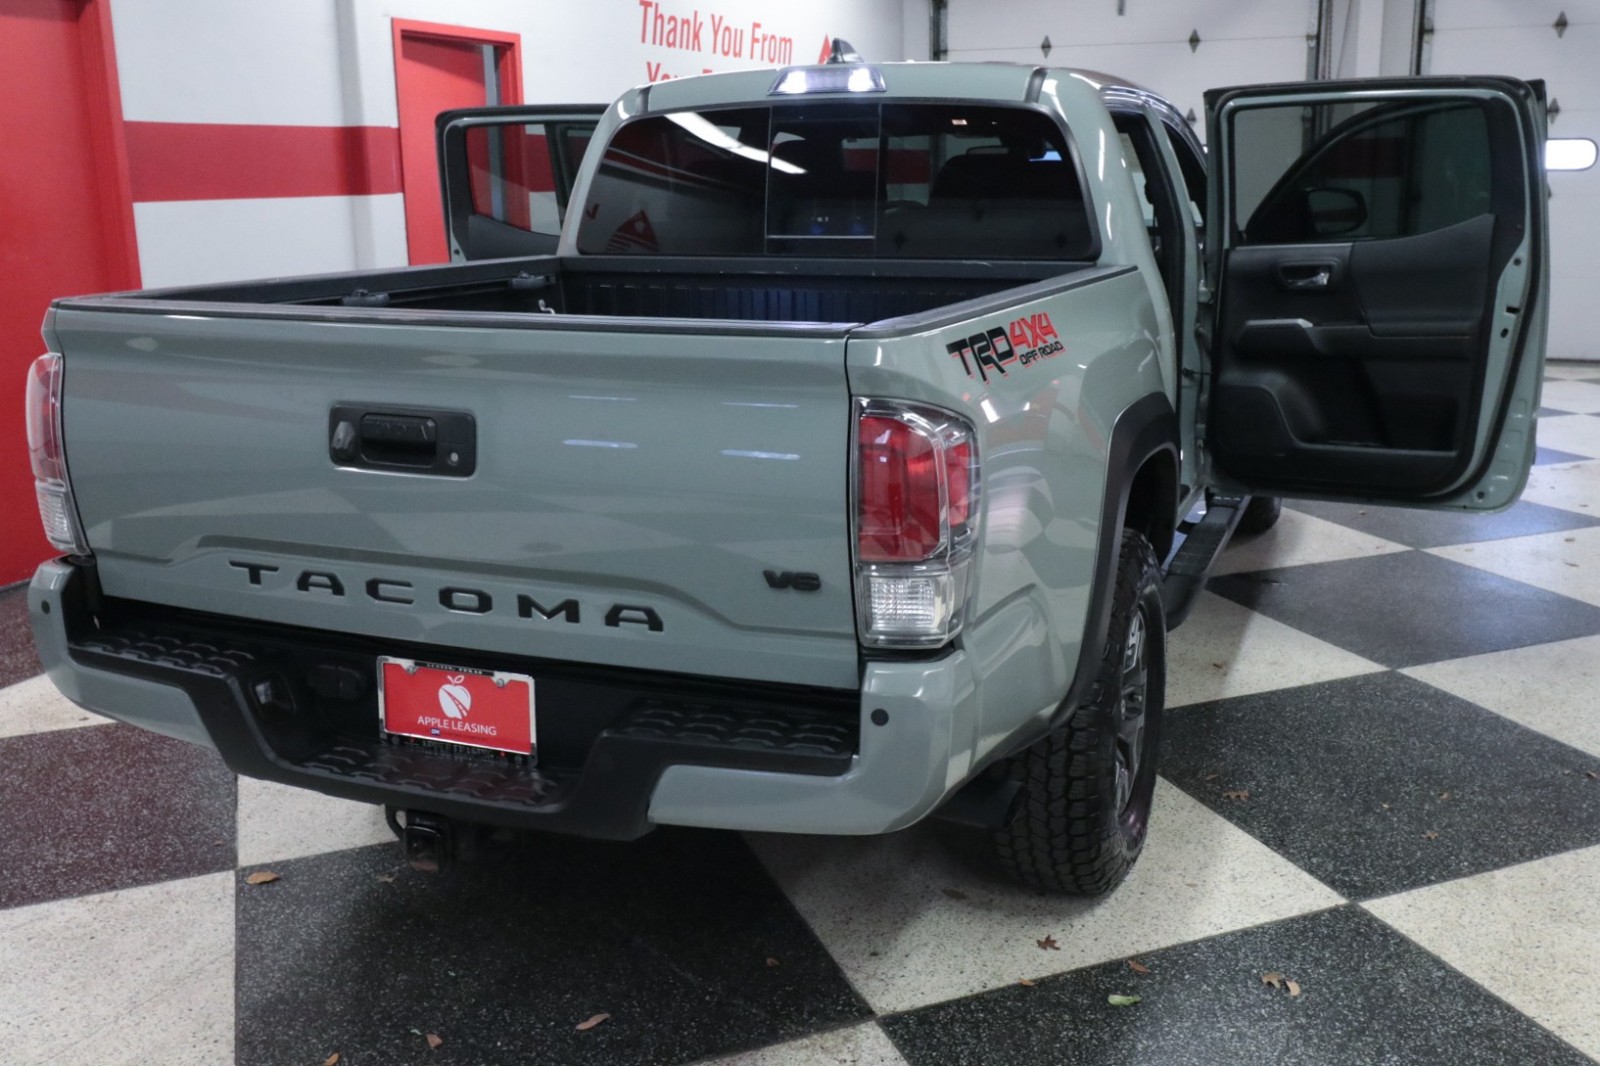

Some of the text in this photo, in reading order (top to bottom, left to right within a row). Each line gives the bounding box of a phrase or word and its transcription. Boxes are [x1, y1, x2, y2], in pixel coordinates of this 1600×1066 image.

[639, 1, 793, 65] Thank You From
[946, 326, 1016, 383] TRD
[1019, 341, 1064, 366] OFF ROAD
[228, 559, 664, 632] TACOMA
[763, 569, 821, 592] V6
[417, 715, 449, 729] APPLE
[451, 720, 497, 736] LEASING
